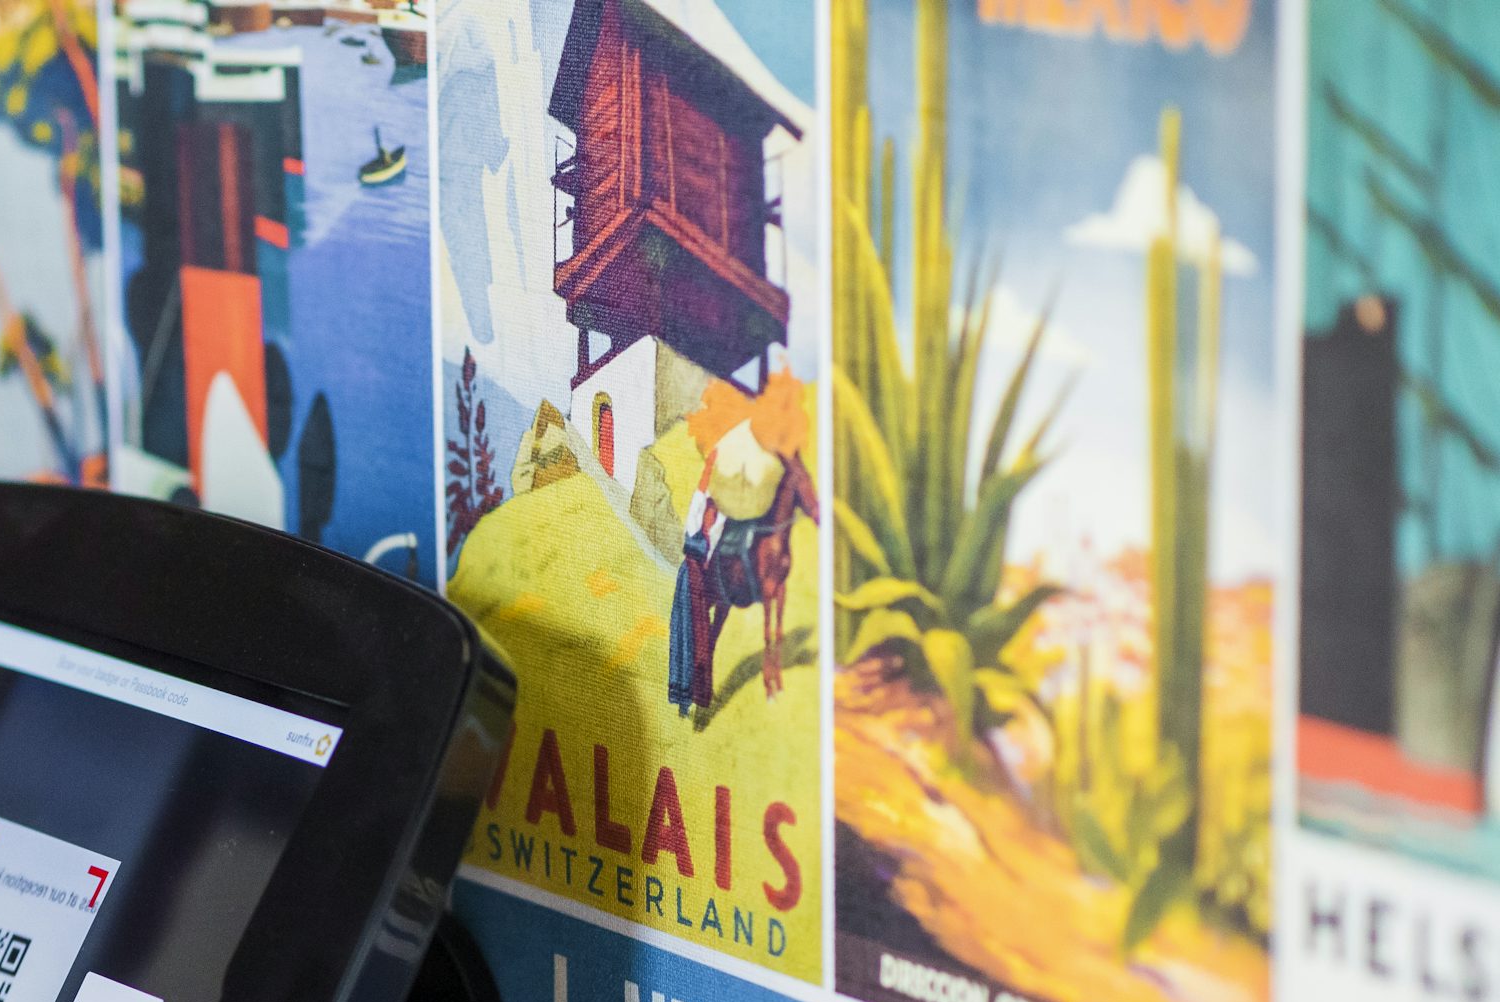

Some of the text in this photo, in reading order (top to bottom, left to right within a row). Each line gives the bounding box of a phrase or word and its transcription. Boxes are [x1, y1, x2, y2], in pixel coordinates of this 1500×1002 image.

[131, 676, 168, 700] Passbook
[167, 690, 189, 707] code
[487, 823, 787, 957] SWITZERLAND
